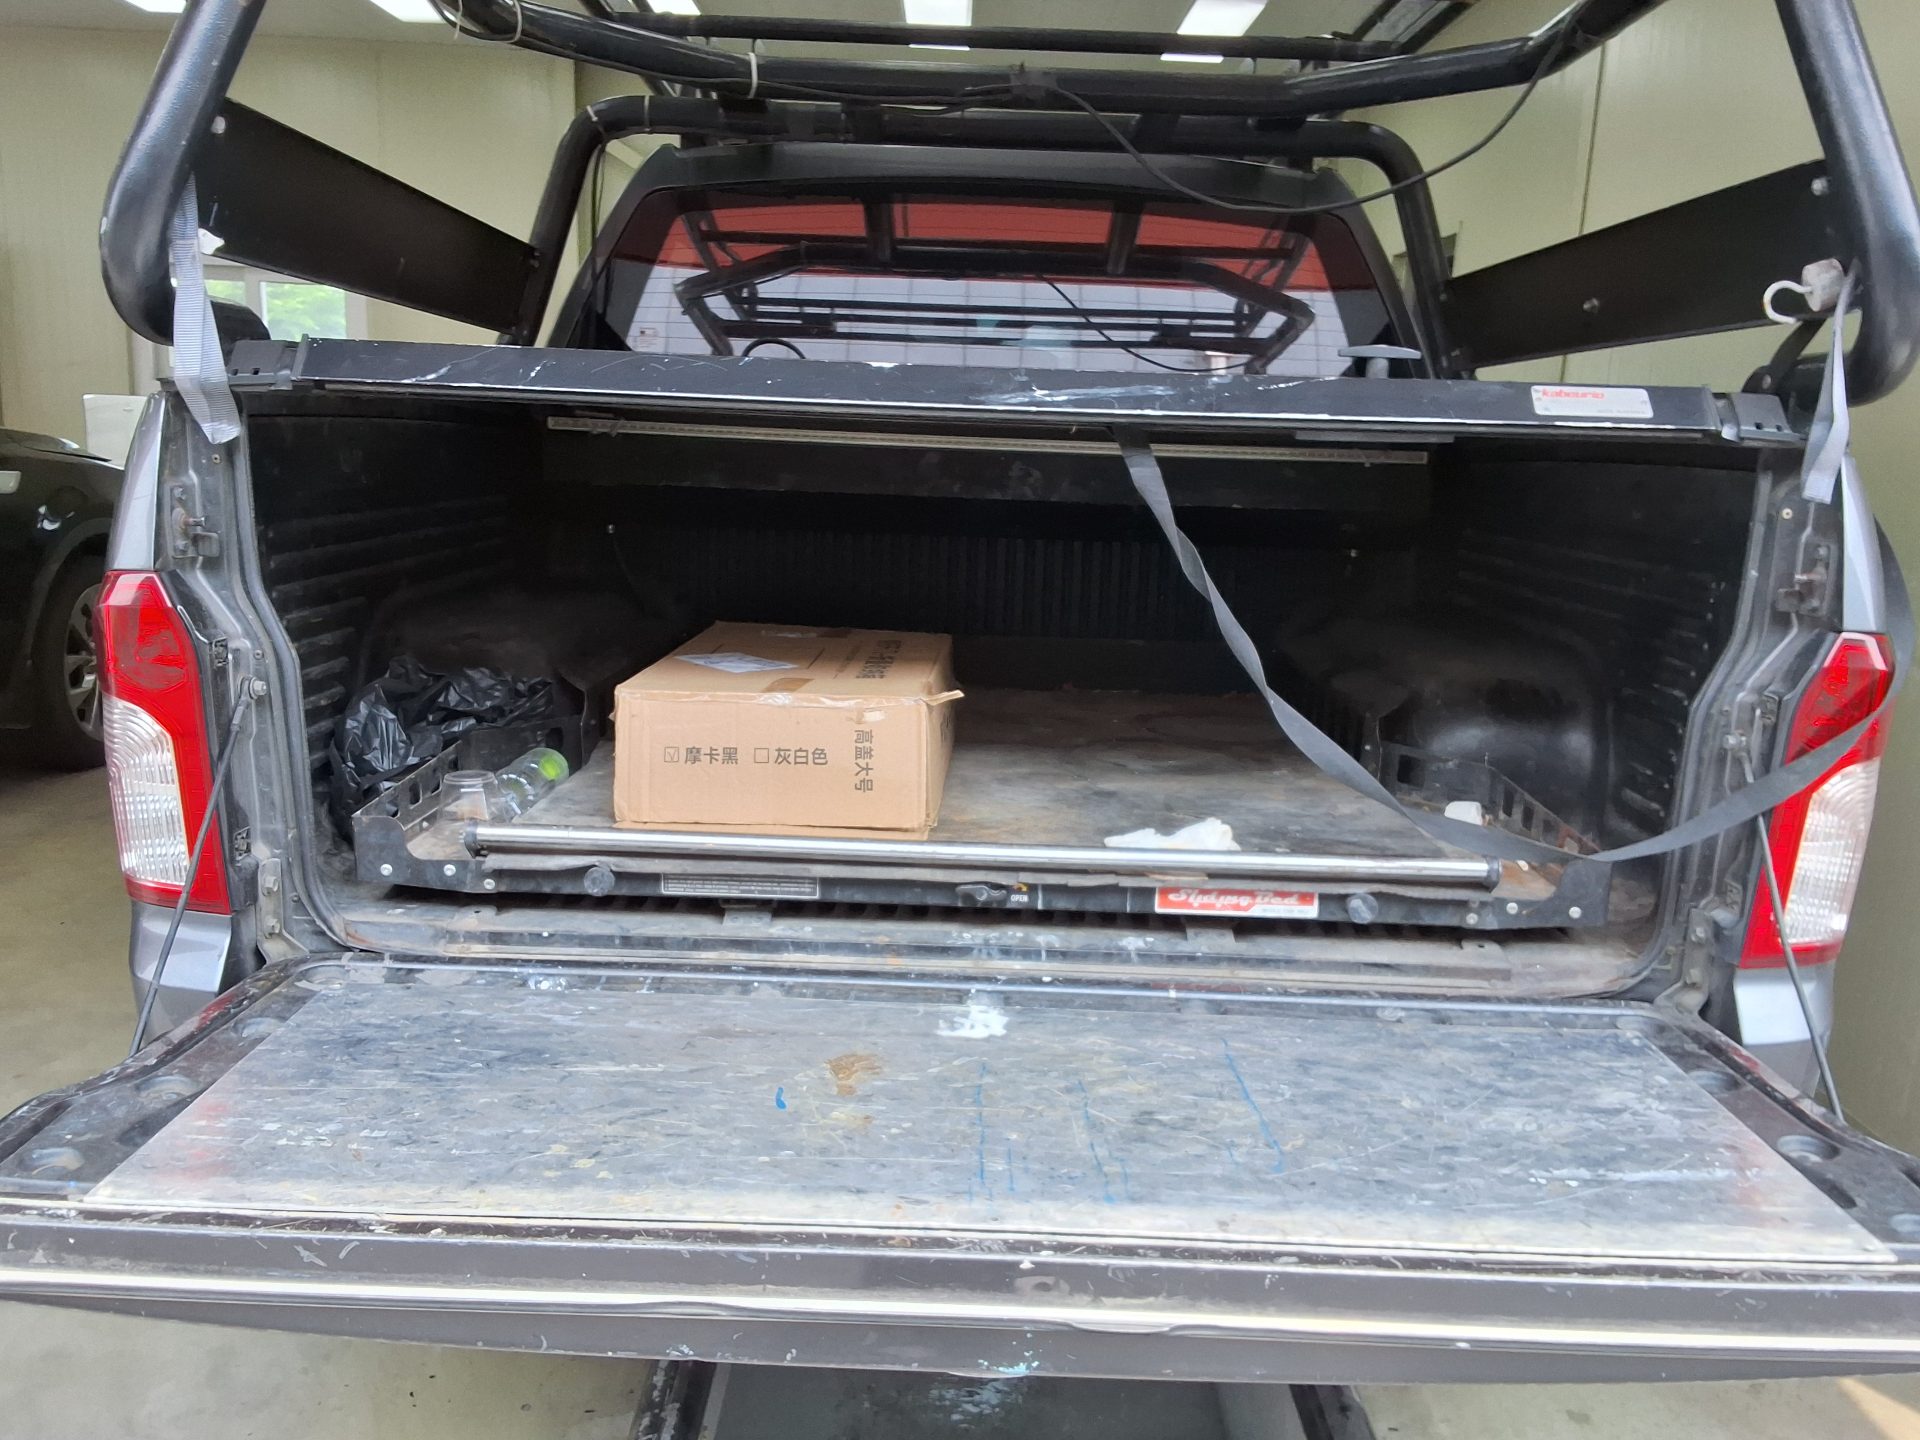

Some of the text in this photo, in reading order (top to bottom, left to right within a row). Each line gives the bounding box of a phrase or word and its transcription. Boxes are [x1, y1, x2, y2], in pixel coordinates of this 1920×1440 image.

[684, 746, 829, 766] 摩卡黑 灰白色
[854, 729, 874, 794] 高盖大号
[1010, 893, 1029, 903] OPEN
